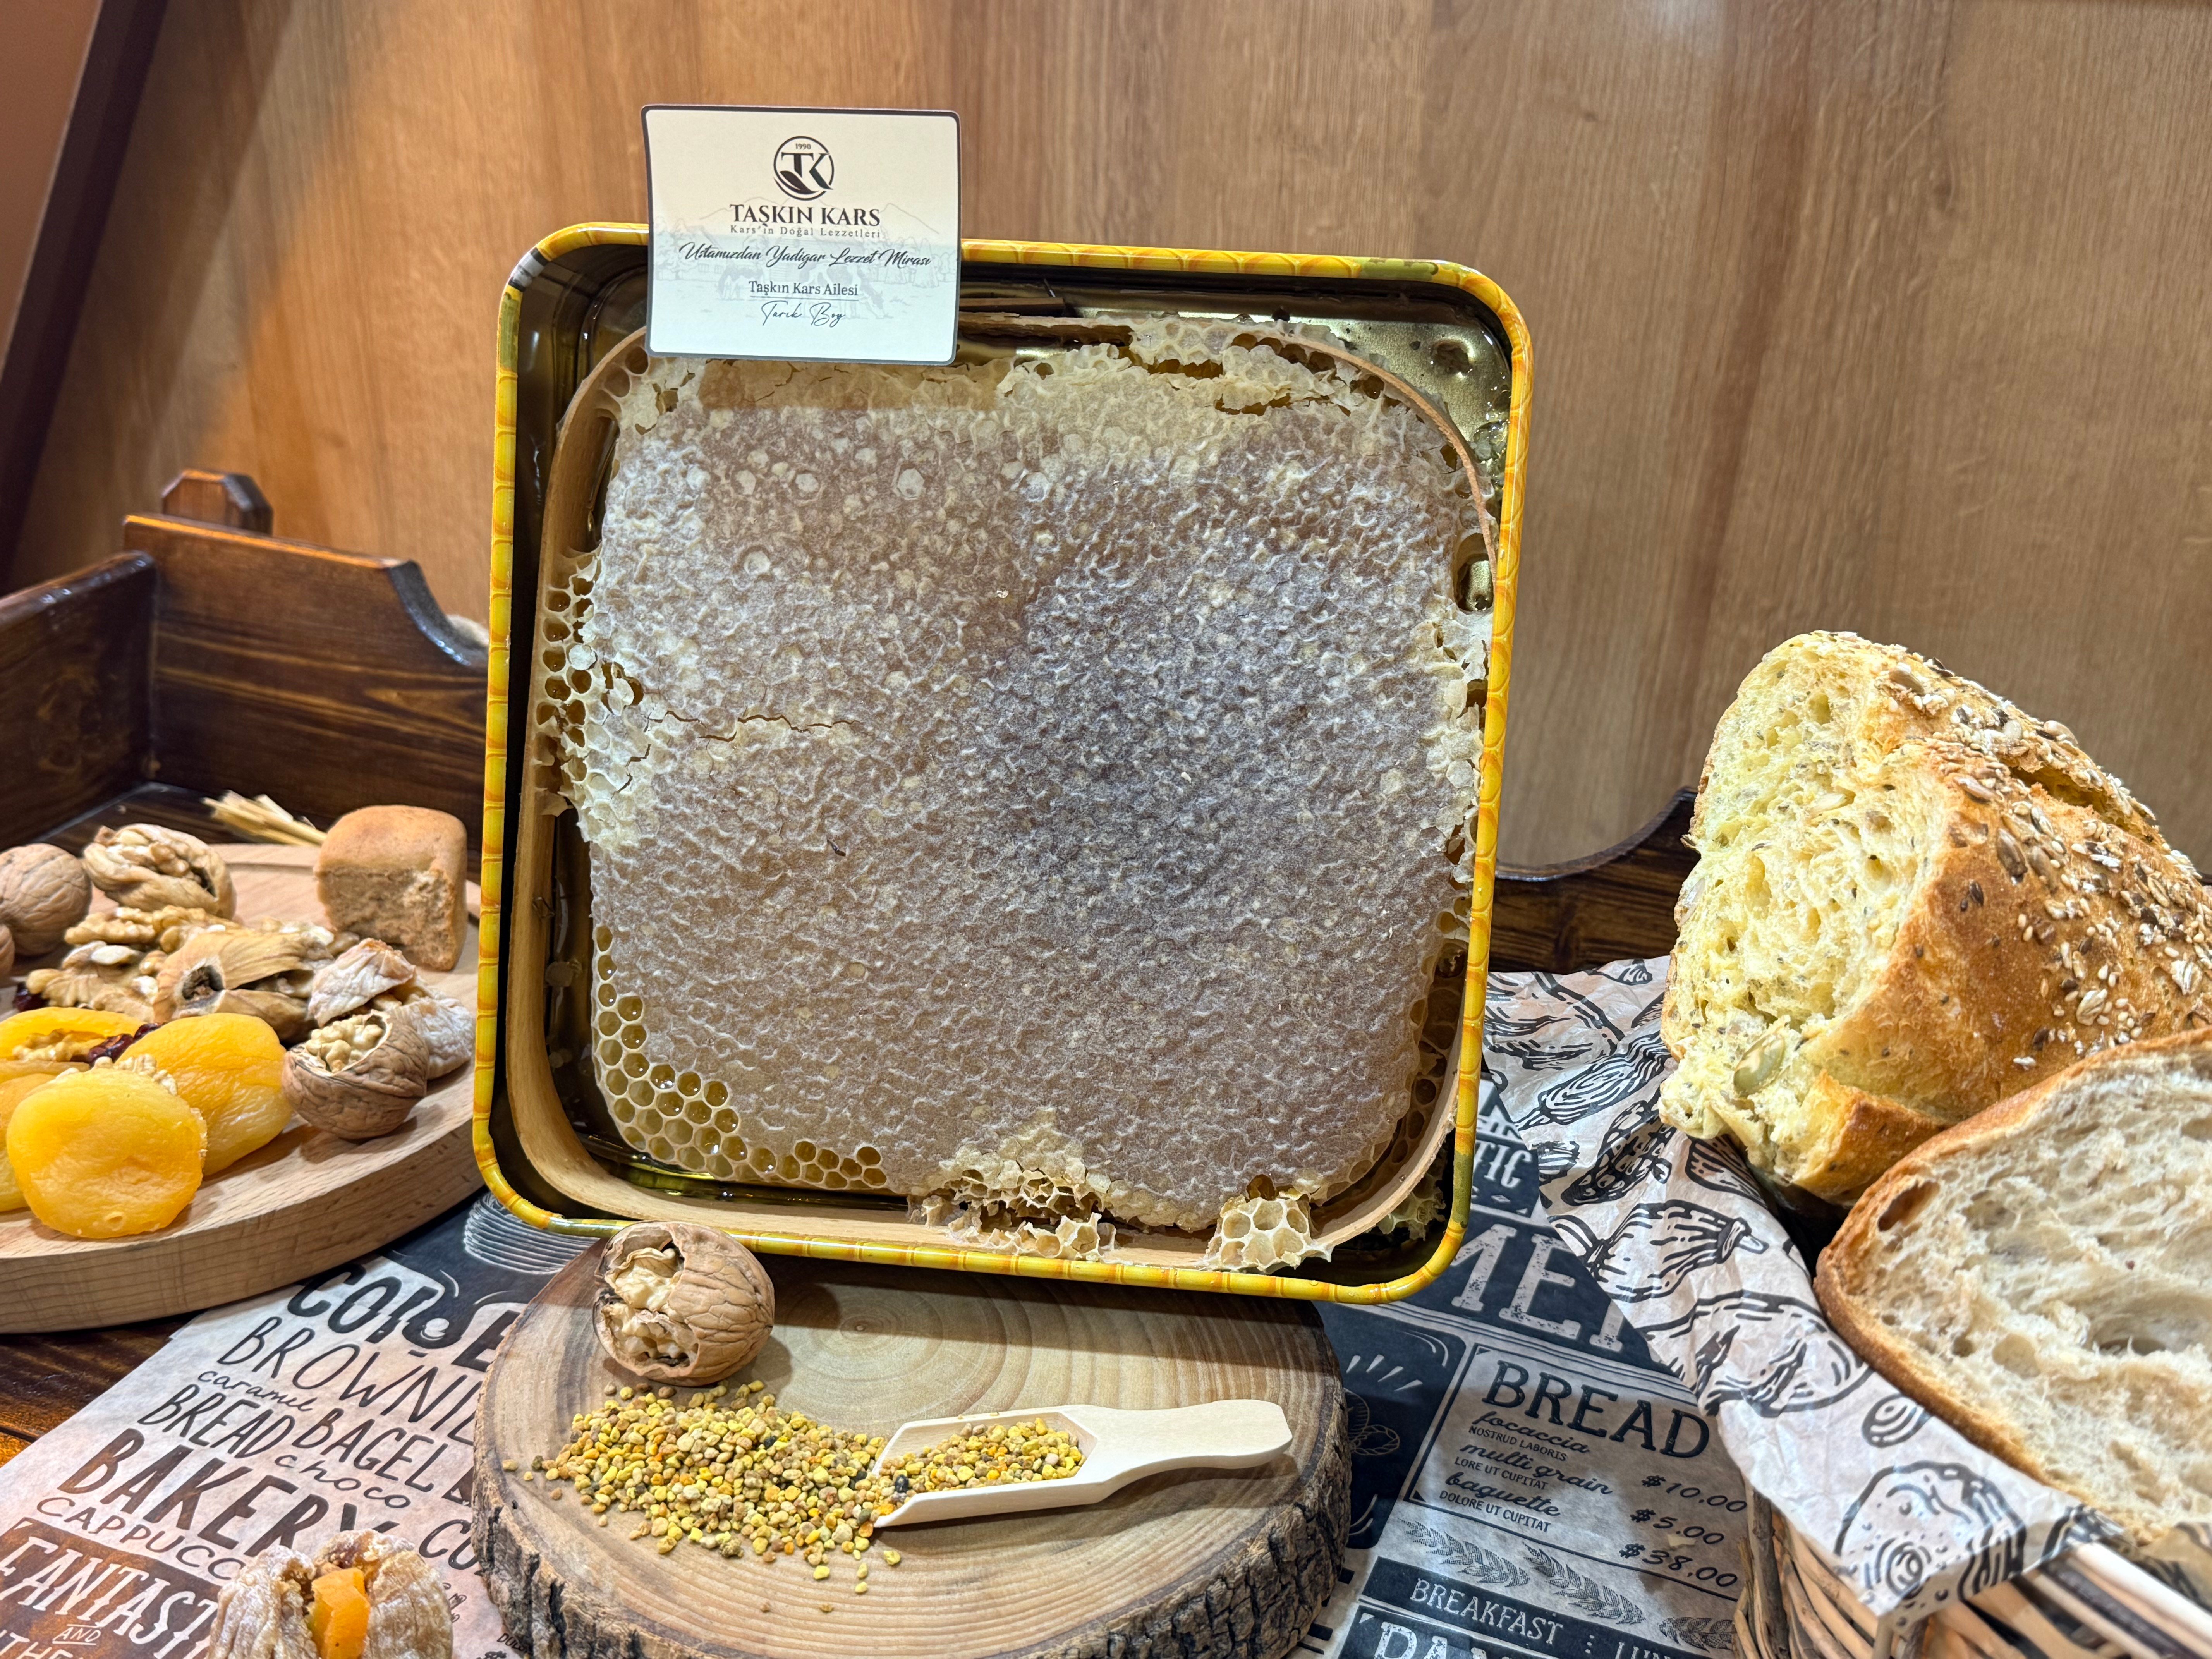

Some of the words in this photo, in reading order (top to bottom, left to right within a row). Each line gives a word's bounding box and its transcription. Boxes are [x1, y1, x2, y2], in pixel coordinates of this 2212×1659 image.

[729, 204, 813, 227] TAŞKIN
[821, 207, 881, 227] KARS
[780, 227, 813, 237] Doğal
[820, 228, 880, 238] Lezzetleri
[766, 245, 827, 269] Yadigar
[829, 247, 877, 267] Lezzet
[878, 249, 933, 269] Mirası
[749, 280, 789, 295] Taşkın
[793, 282, 821, 295] Kars
[825, 283, 859, 296] Ailesi
[198, 1370, 318, 1412] caramel
[1481, 1360, 1710, 1459] BREAD
[137, 1384, 295, 1459] BREAD
[292, 1408, 448, 1492] BAGEL
[1468, 1425, 1517, 1445] NOSTRUD
[1519, 1440, 1568, 1462] LABORIS
[1472, 1410, 1590, 1454] focaccia
[274, 1454, 411, 1510] choco
[1455, 1456, 1483, 1471] LORE
[1484, 1465, 1501, 1475] UT
[1501, 1470, 1549, 1491] CUPITAT
[1459, 1444, 1534, 1470] multi
[1532, 1463, 1613, 1494] grain
[1439, 1491, 1484, 1511] DOLORE
[1486, 1503, 1501, 1516] UT
[1502, 1509, 1551, 1532] CUPITAT
[1445, 1471, 1561, 1516] baguette
[1641, 1475, 1748, 1512] $10.00
[36, 1496, 246, 1580] CAPPUCC
[1630, 1508, 1724, 1545] $5.00
[1619, 1542, 1738, 1587] $38.00
[1410, 1577, 1565, 1646] BREAKFAST
[53, 1626, 101, 1642] AND
